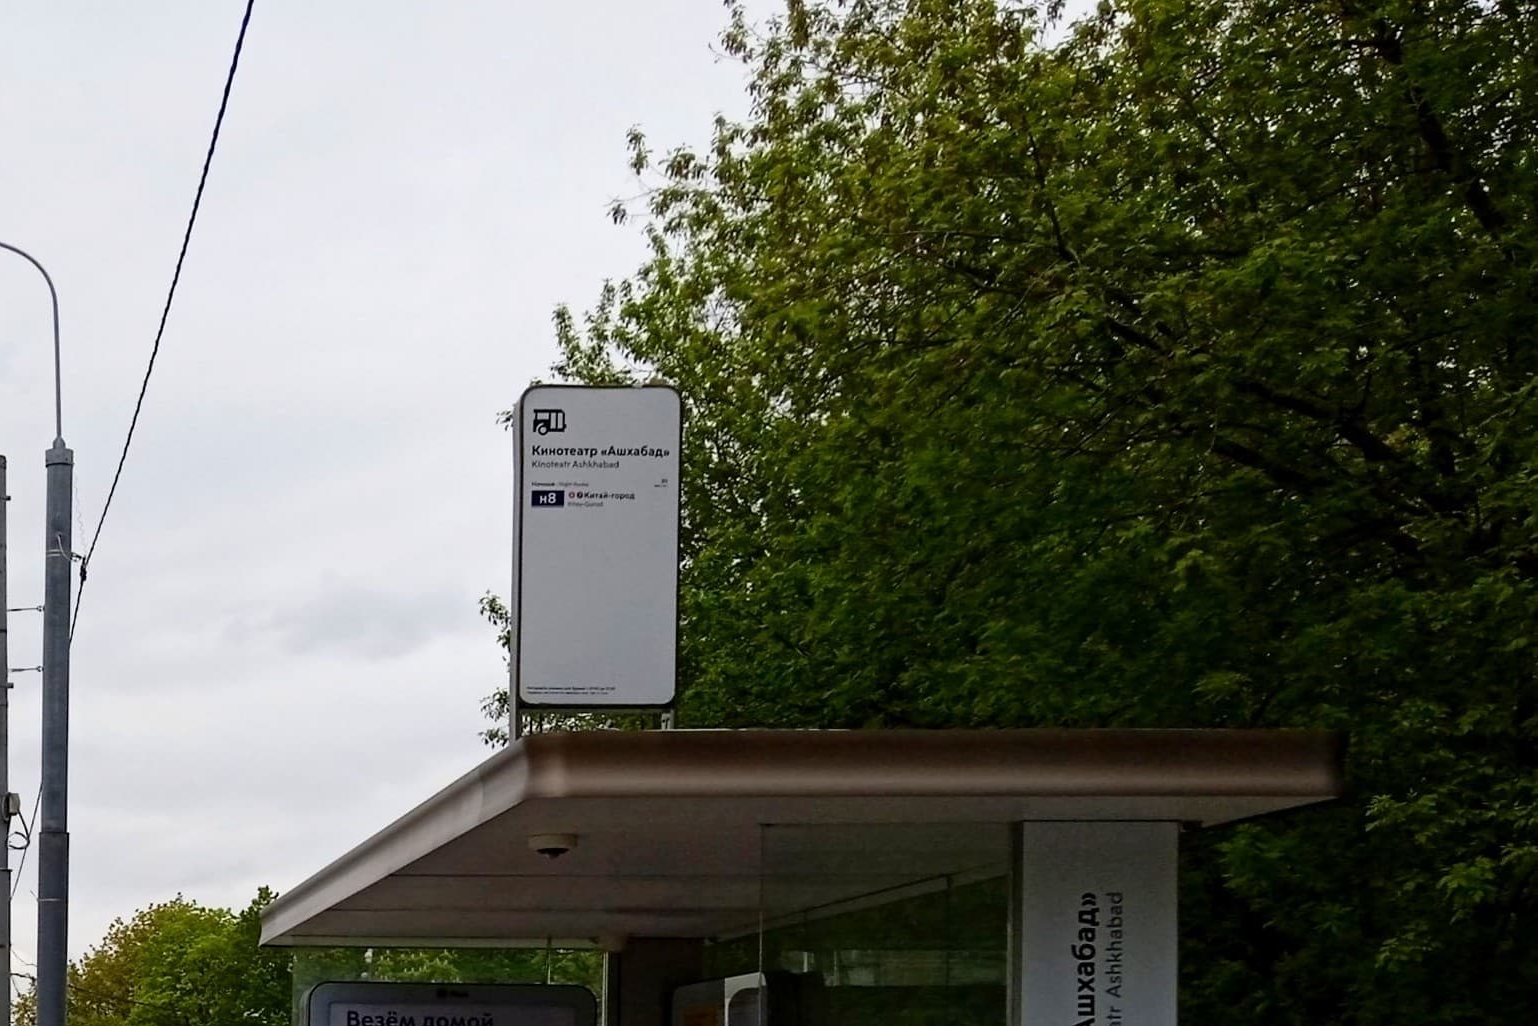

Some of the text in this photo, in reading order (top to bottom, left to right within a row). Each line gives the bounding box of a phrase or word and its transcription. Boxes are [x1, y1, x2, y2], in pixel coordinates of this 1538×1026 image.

[532, 446, 670, 458] Кинотеатр «Ашхабад»
[531, 460, 620, 469] Kinoteatr Ashkhabad
[539, 492, 557, 504] н8
[1105, 892, 1124, 999] Ashkhabad
